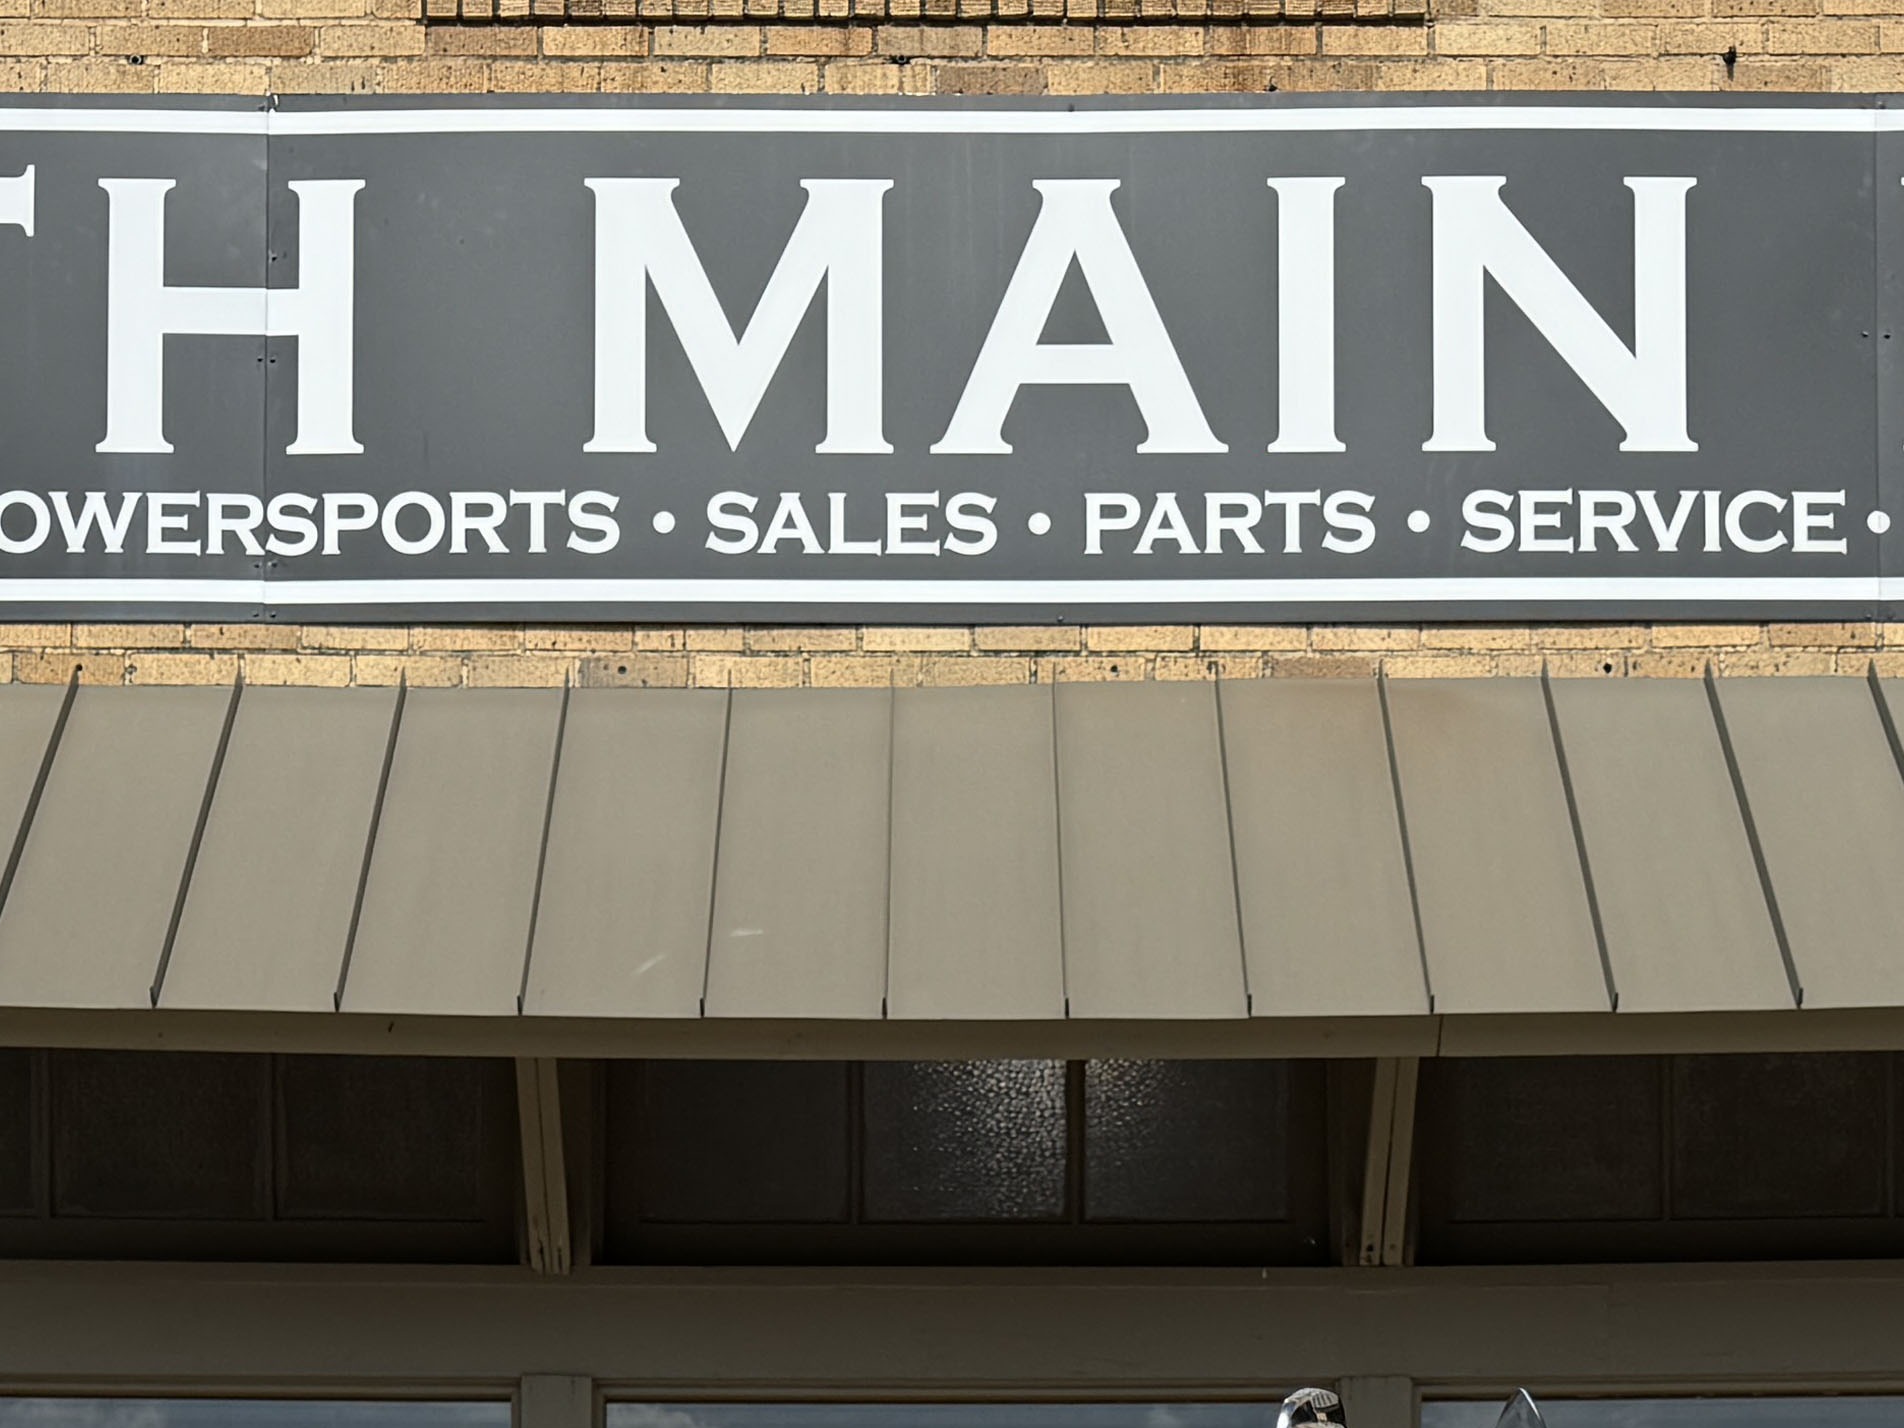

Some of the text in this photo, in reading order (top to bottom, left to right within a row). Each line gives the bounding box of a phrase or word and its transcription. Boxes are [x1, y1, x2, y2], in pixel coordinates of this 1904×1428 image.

[583, 175, 1699, 455] MAIN
[706, 490, 997, 556] SALES
[1085, 488, 1375, 555] PARTS
[1461, 488, 1847, 555] SERVICE
